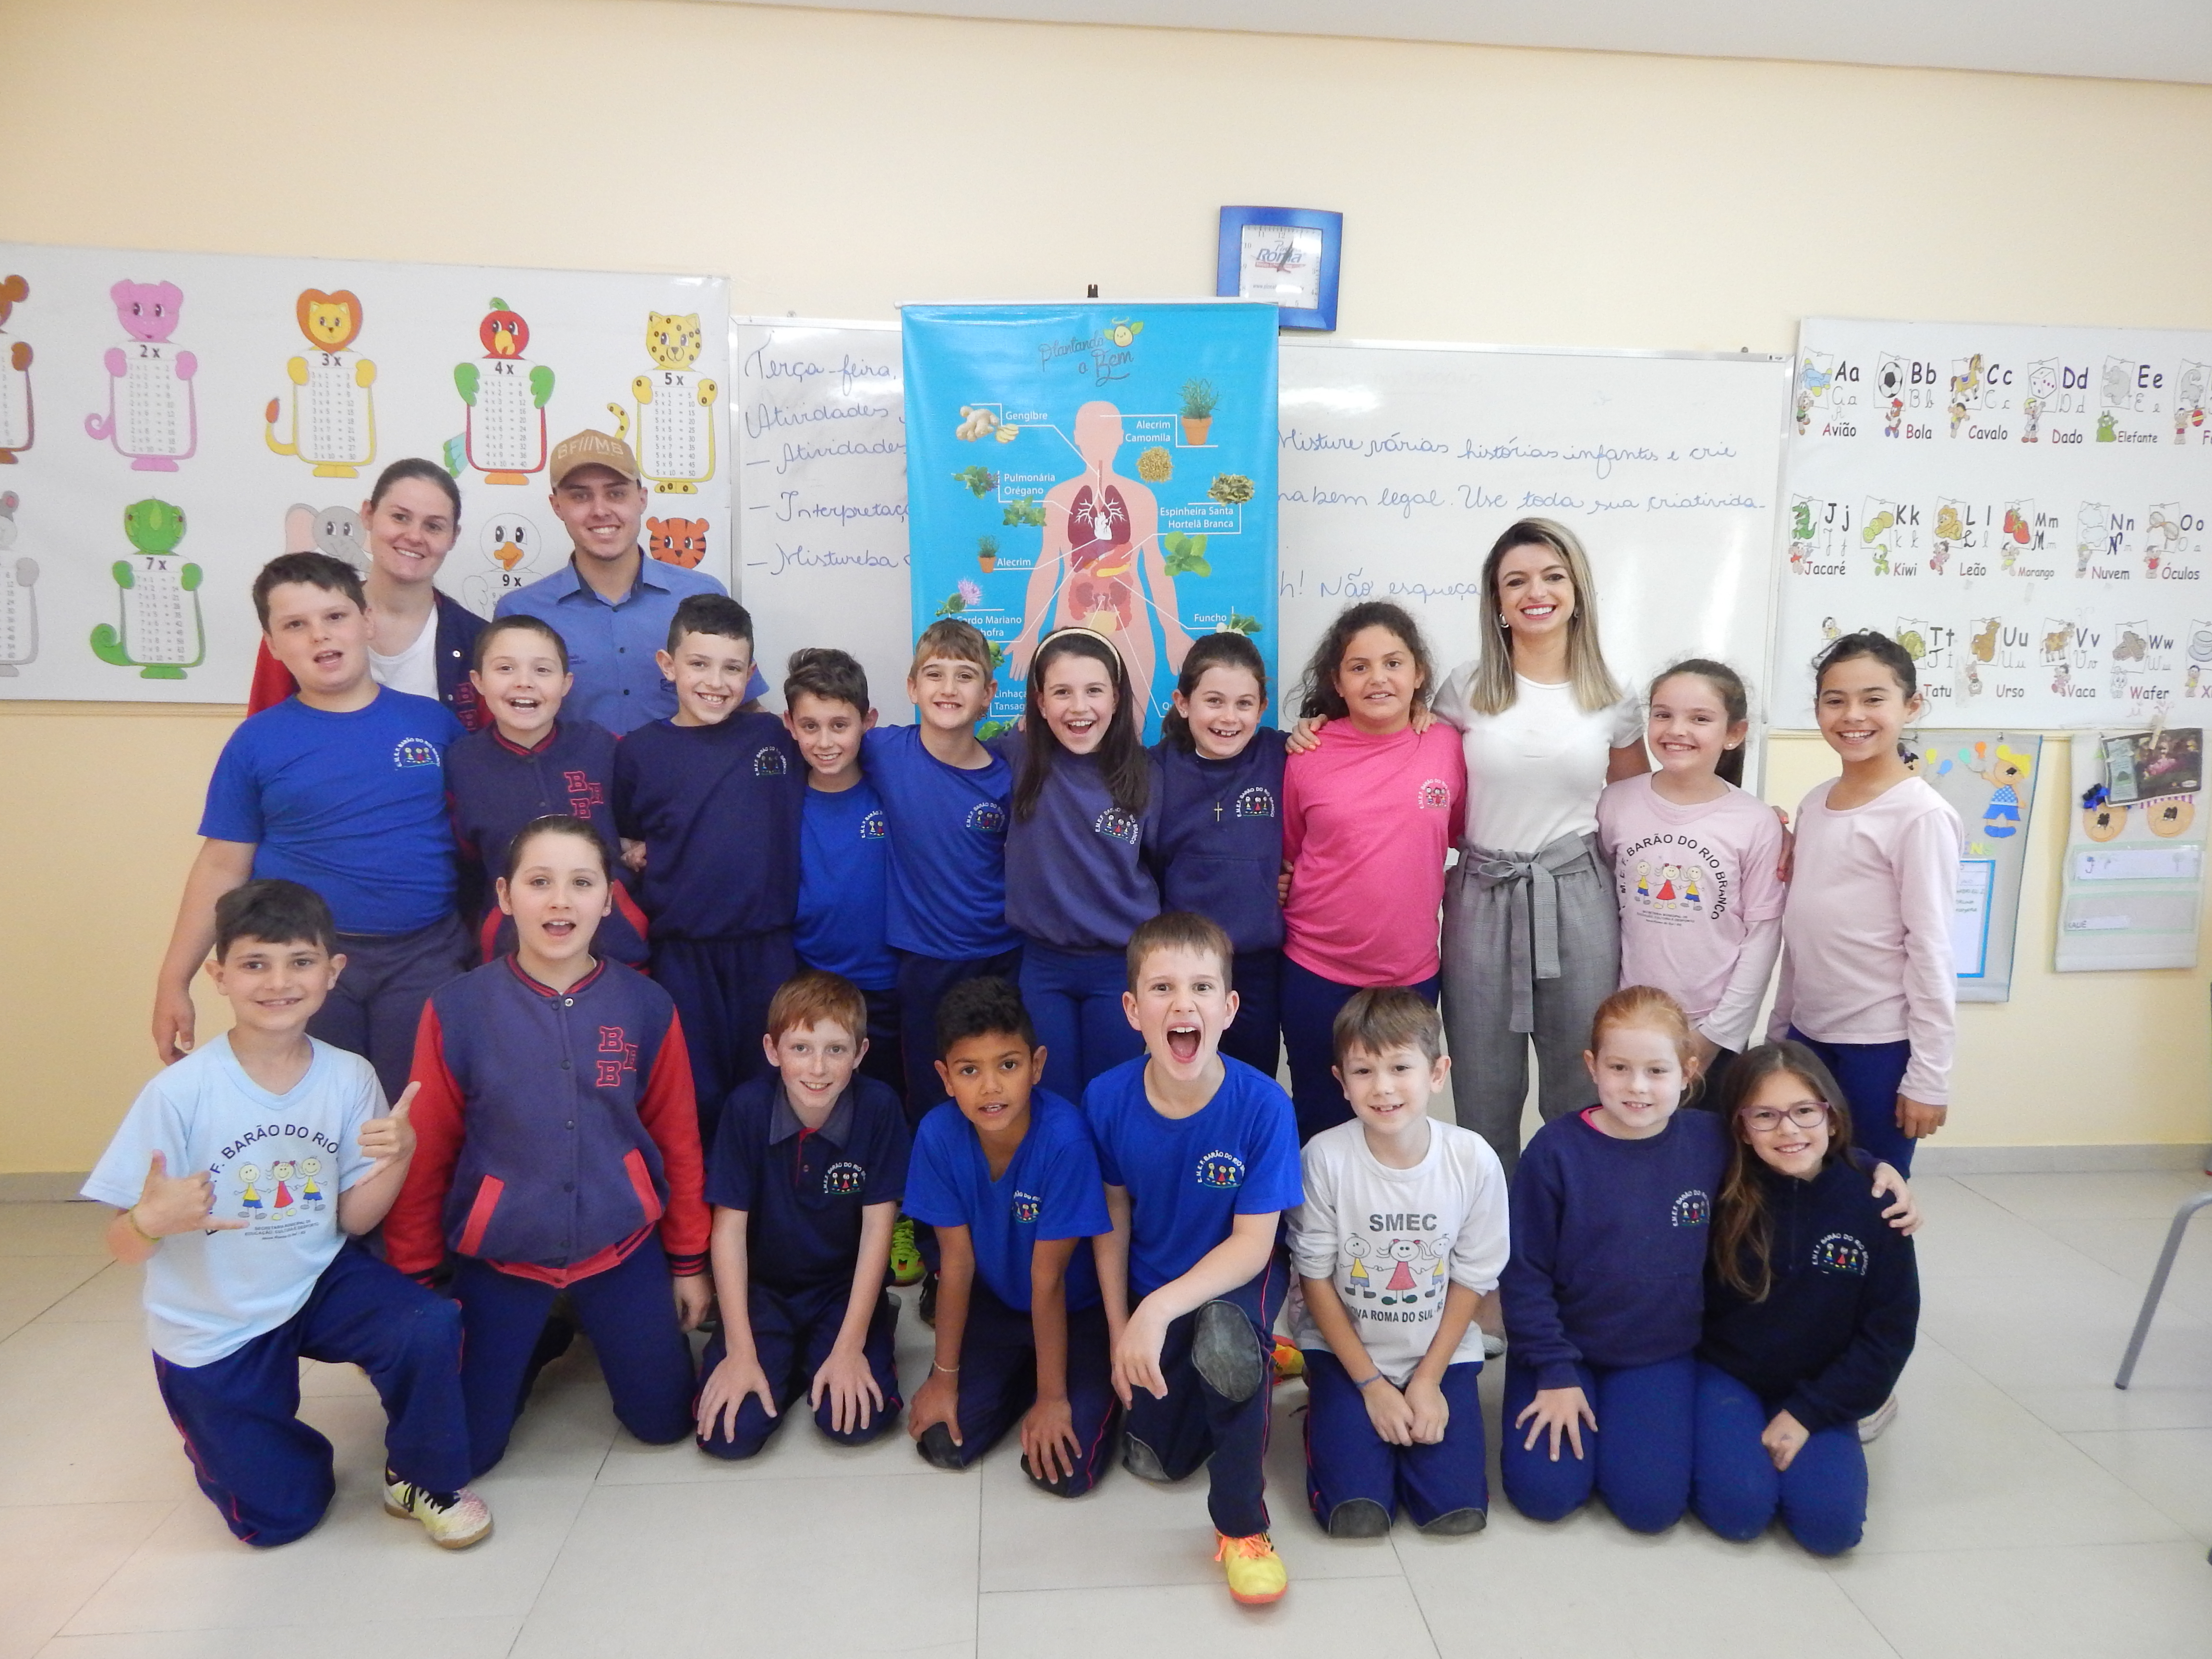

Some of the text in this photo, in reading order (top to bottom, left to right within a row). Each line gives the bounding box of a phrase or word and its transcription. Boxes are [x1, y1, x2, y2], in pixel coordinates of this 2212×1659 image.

[1006, 410, 1048, 421] Gengibre
[1136, 420, 1170, 429] Alecrim
[1823, 422, 1856, 436] Avião
[1125, 433, 1170, 442] Camomila
[1906, 424, 1932, 439] Bola
[1969, 425, 2008, 440] Cavalo
[2052, 429, 2082, 443] Dado
[2118, 431, 2157, 443] Elefante
[1457, 437, 1558, 459] histórias
[1667, 449, 1679, 461] e
[1690, 442, 1736, 460] crie
[1004, 473, 1056, 482] Pulmonária
[1004, 485, 1044, 496] Orégano
[1458, 484, 1508, 508] Use
[1517, 491, 1585, 510] toda
[1587, 496, 1639, 514] sua
[1160, 506, 1233, 517] Espinheira Santa
[1168, 519, 1233, 528] Hortelã Branca
[997, 558, 1031, 566] Alecrim
[1804, 561, 1846, 575] Jacaré
[1894, 563, 1917, 576] Kiwi
[1960, 563, 1986, 576] Leão
[2092, 566, 2130, 580] Nuvem
[2162, 563, 2200, 580] Óculos
[1321, 567, 1373, 598] Não
[1194, 613, 1226, 622] Funcho
[1923, 684, 1951, 697] Tatu
[1996, 684, 2024, 697] Urso
[2068, 685, 2095, 697] Vaca
[2131, 685, 2169, 700] Wafer
[995, 702, 1025, 711] Tansag
[1626, 833, 1673, 856] BARÃO
[1678, 836, 1697, 849] DO
[1698, 847, 1719, 868] RIO
[1711, 871, 1728, 920] BRANCO
[221, 1124, 279, 1159] BARÃO
[285, 1124, 309, 1138] DO
[312, 1132, 338, 1154] RIO
[1370, 1214, 1437, 1232] SMEC
[1371, 1310, 1399, 1322] ROMA
[1402, 1312, 1415, 1322] DO
[1419, 1309, 1433, 1322] SUL
